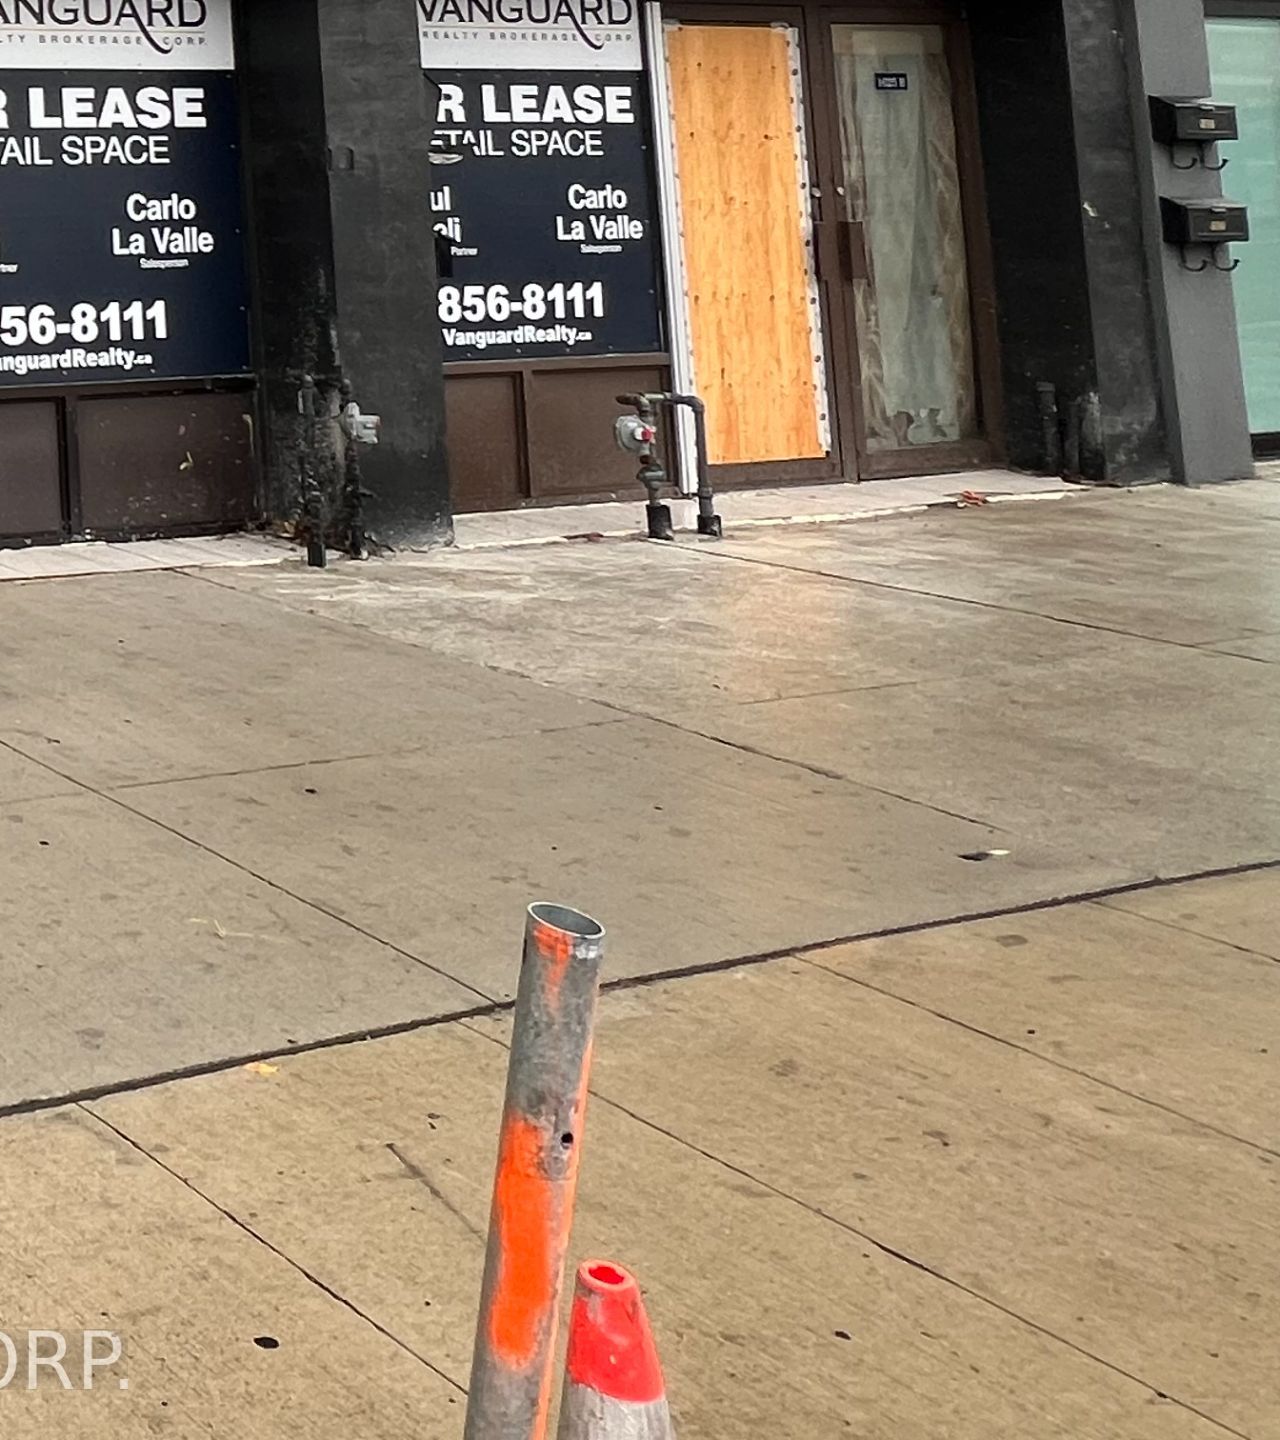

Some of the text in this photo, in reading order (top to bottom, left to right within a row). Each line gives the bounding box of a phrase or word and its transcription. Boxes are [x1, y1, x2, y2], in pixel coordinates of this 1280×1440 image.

[39, 34, 142, 46] BROKERAGE
[28, 86, 207, 130] LEASE
[481, 84, 635, 124] LEASE
[61, 135, 171, 165] SPACE
[511, 129, 604, 156] SPACE
[126, 192, 196, 222] Carlo
[568, 184, 627, 210] Carlo
[111, 226, 215, 256] La Valle
[556, 215, 643, 241] La Valle
[438, 281, 604, 323] 856-8111
